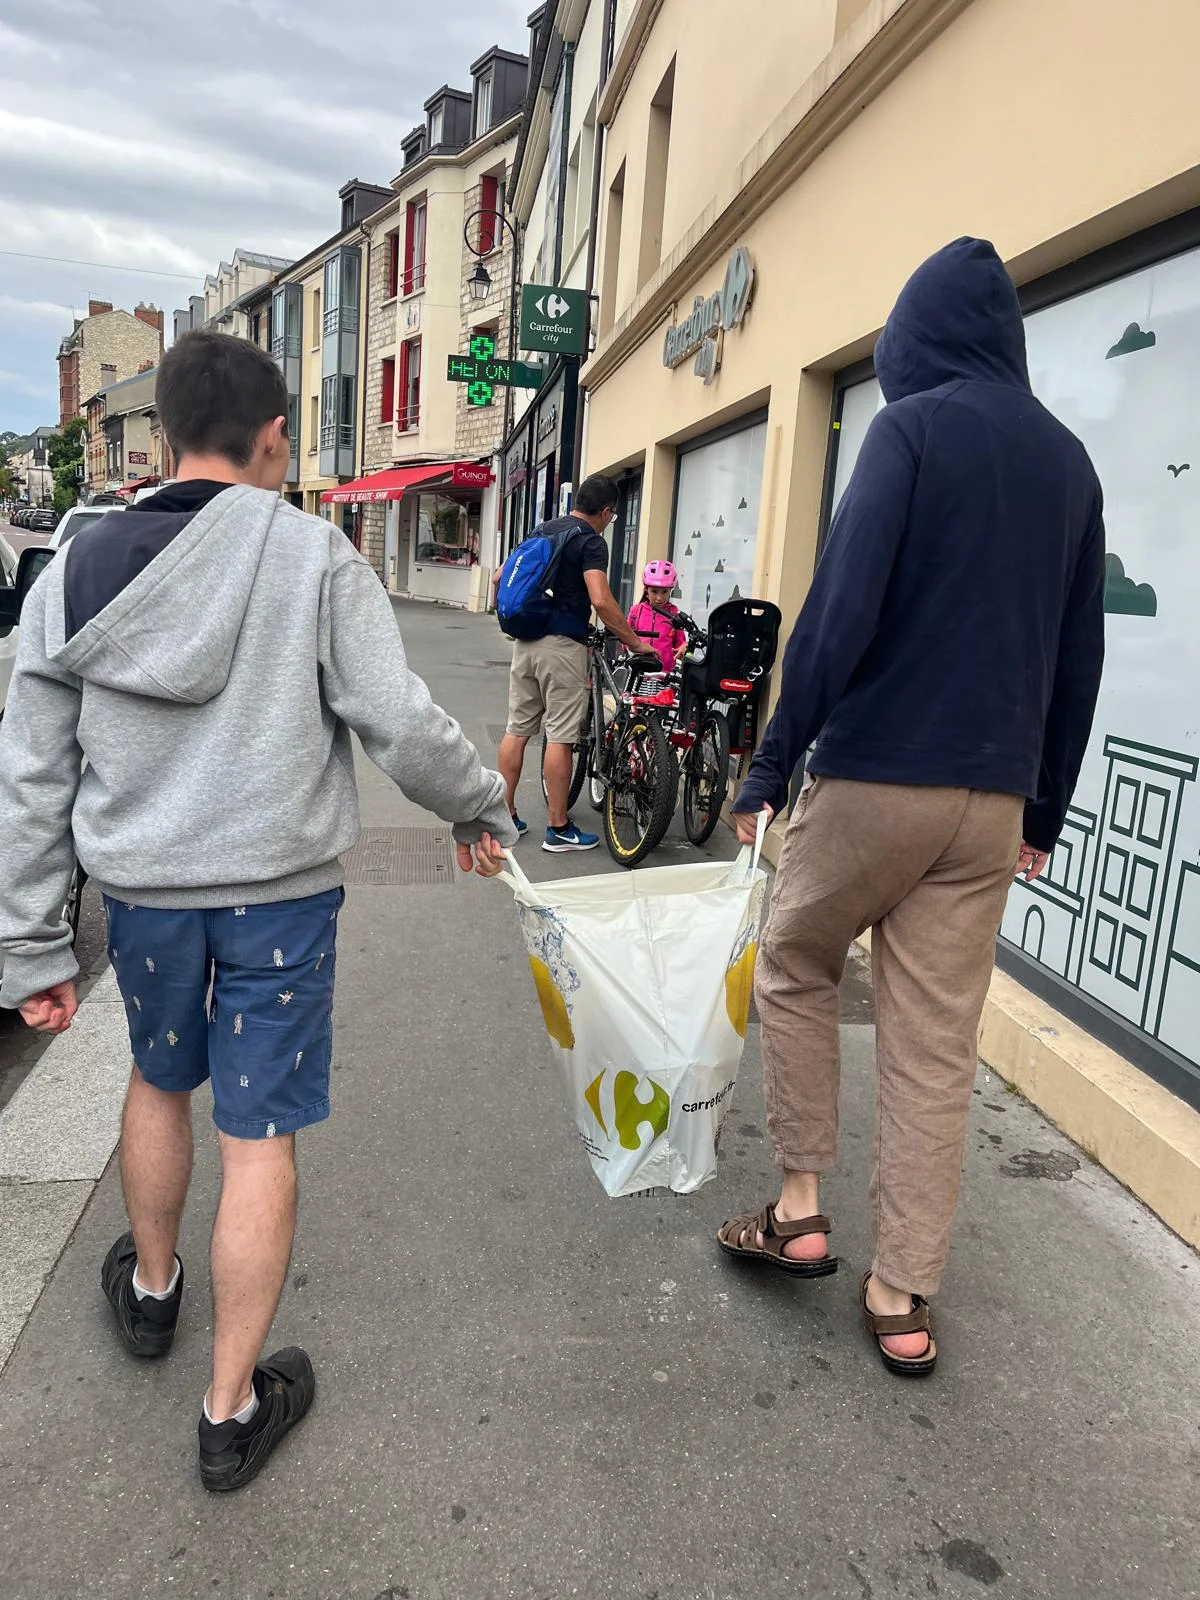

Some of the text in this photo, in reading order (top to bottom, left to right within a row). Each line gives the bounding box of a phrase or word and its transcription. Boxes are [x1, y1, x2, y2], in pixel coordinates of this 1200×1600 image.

[529, 321, 573, 335] Carrefour
[542, 333, 559, 345] city
[331, 493, 350, 502] INSTITUT
[350, 493, 357, 502] DE
[681, 1080, 736, 1113] carrefor.fr
